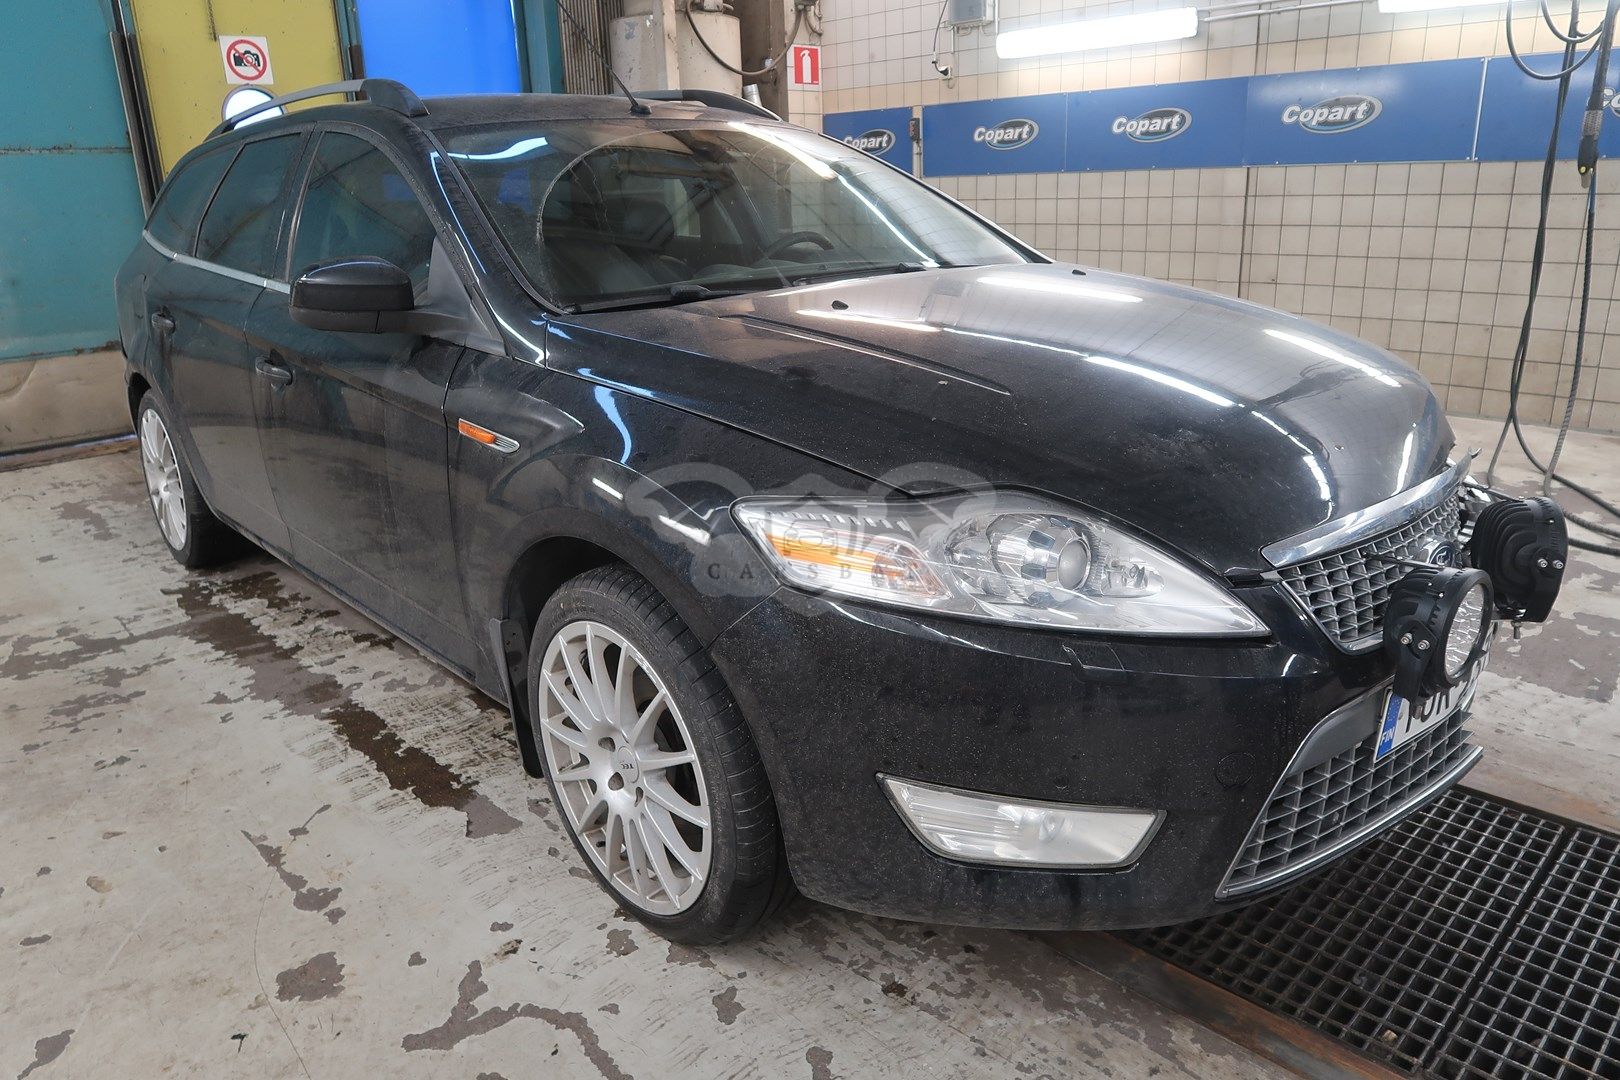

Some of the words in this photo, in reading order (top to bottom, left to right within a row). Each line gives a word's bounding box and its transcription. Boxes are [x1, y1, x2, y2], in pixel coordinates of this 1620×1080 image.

[1112, 113, 1182, 135] Copart
[1282, 101, 1369, 126] Copart
[844, 133, 888, 150] Copart
[973, 122, 1030, 143] Copart
[1380, 727, 1395, 745] FIN
